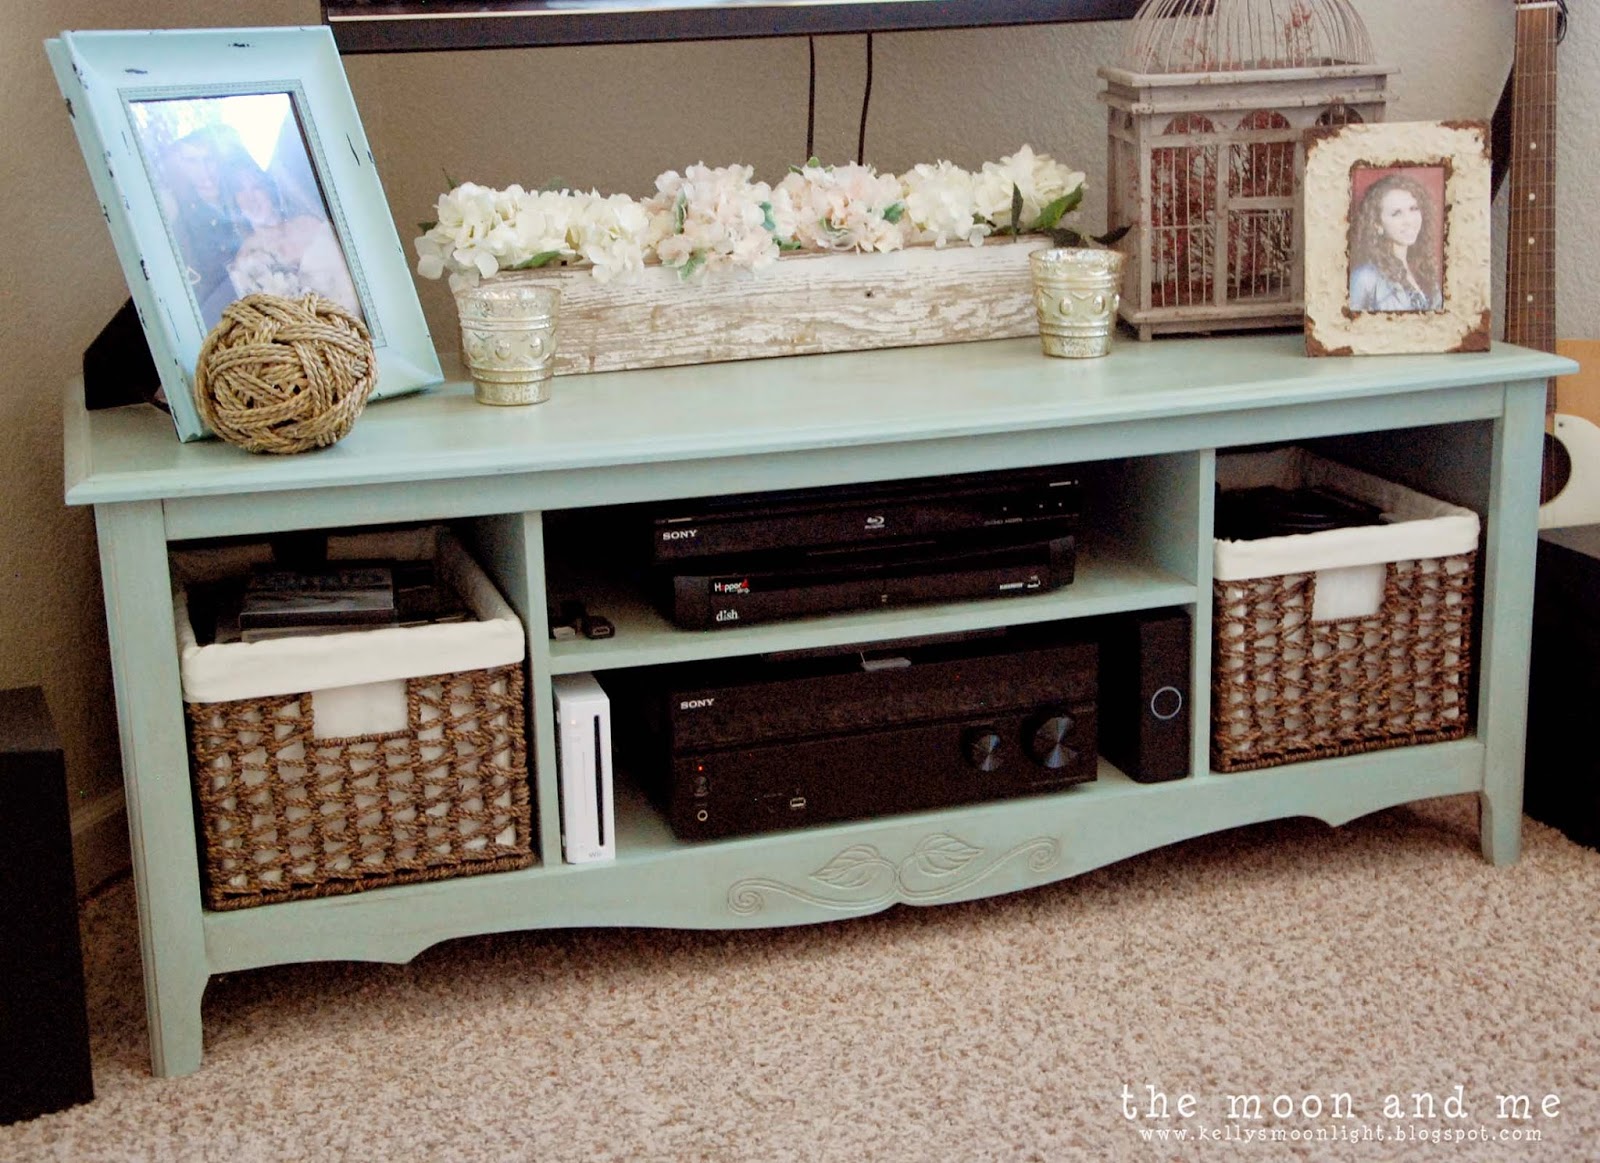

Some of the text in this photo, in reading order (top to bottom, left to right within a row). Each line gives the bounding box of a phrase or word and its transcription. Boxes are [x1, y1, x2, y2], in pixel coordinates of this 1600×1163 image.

[662, 529, 698, 541] SONY
[716, 609, 739, 622] dish
[680, 698, 715, 710] SONY
